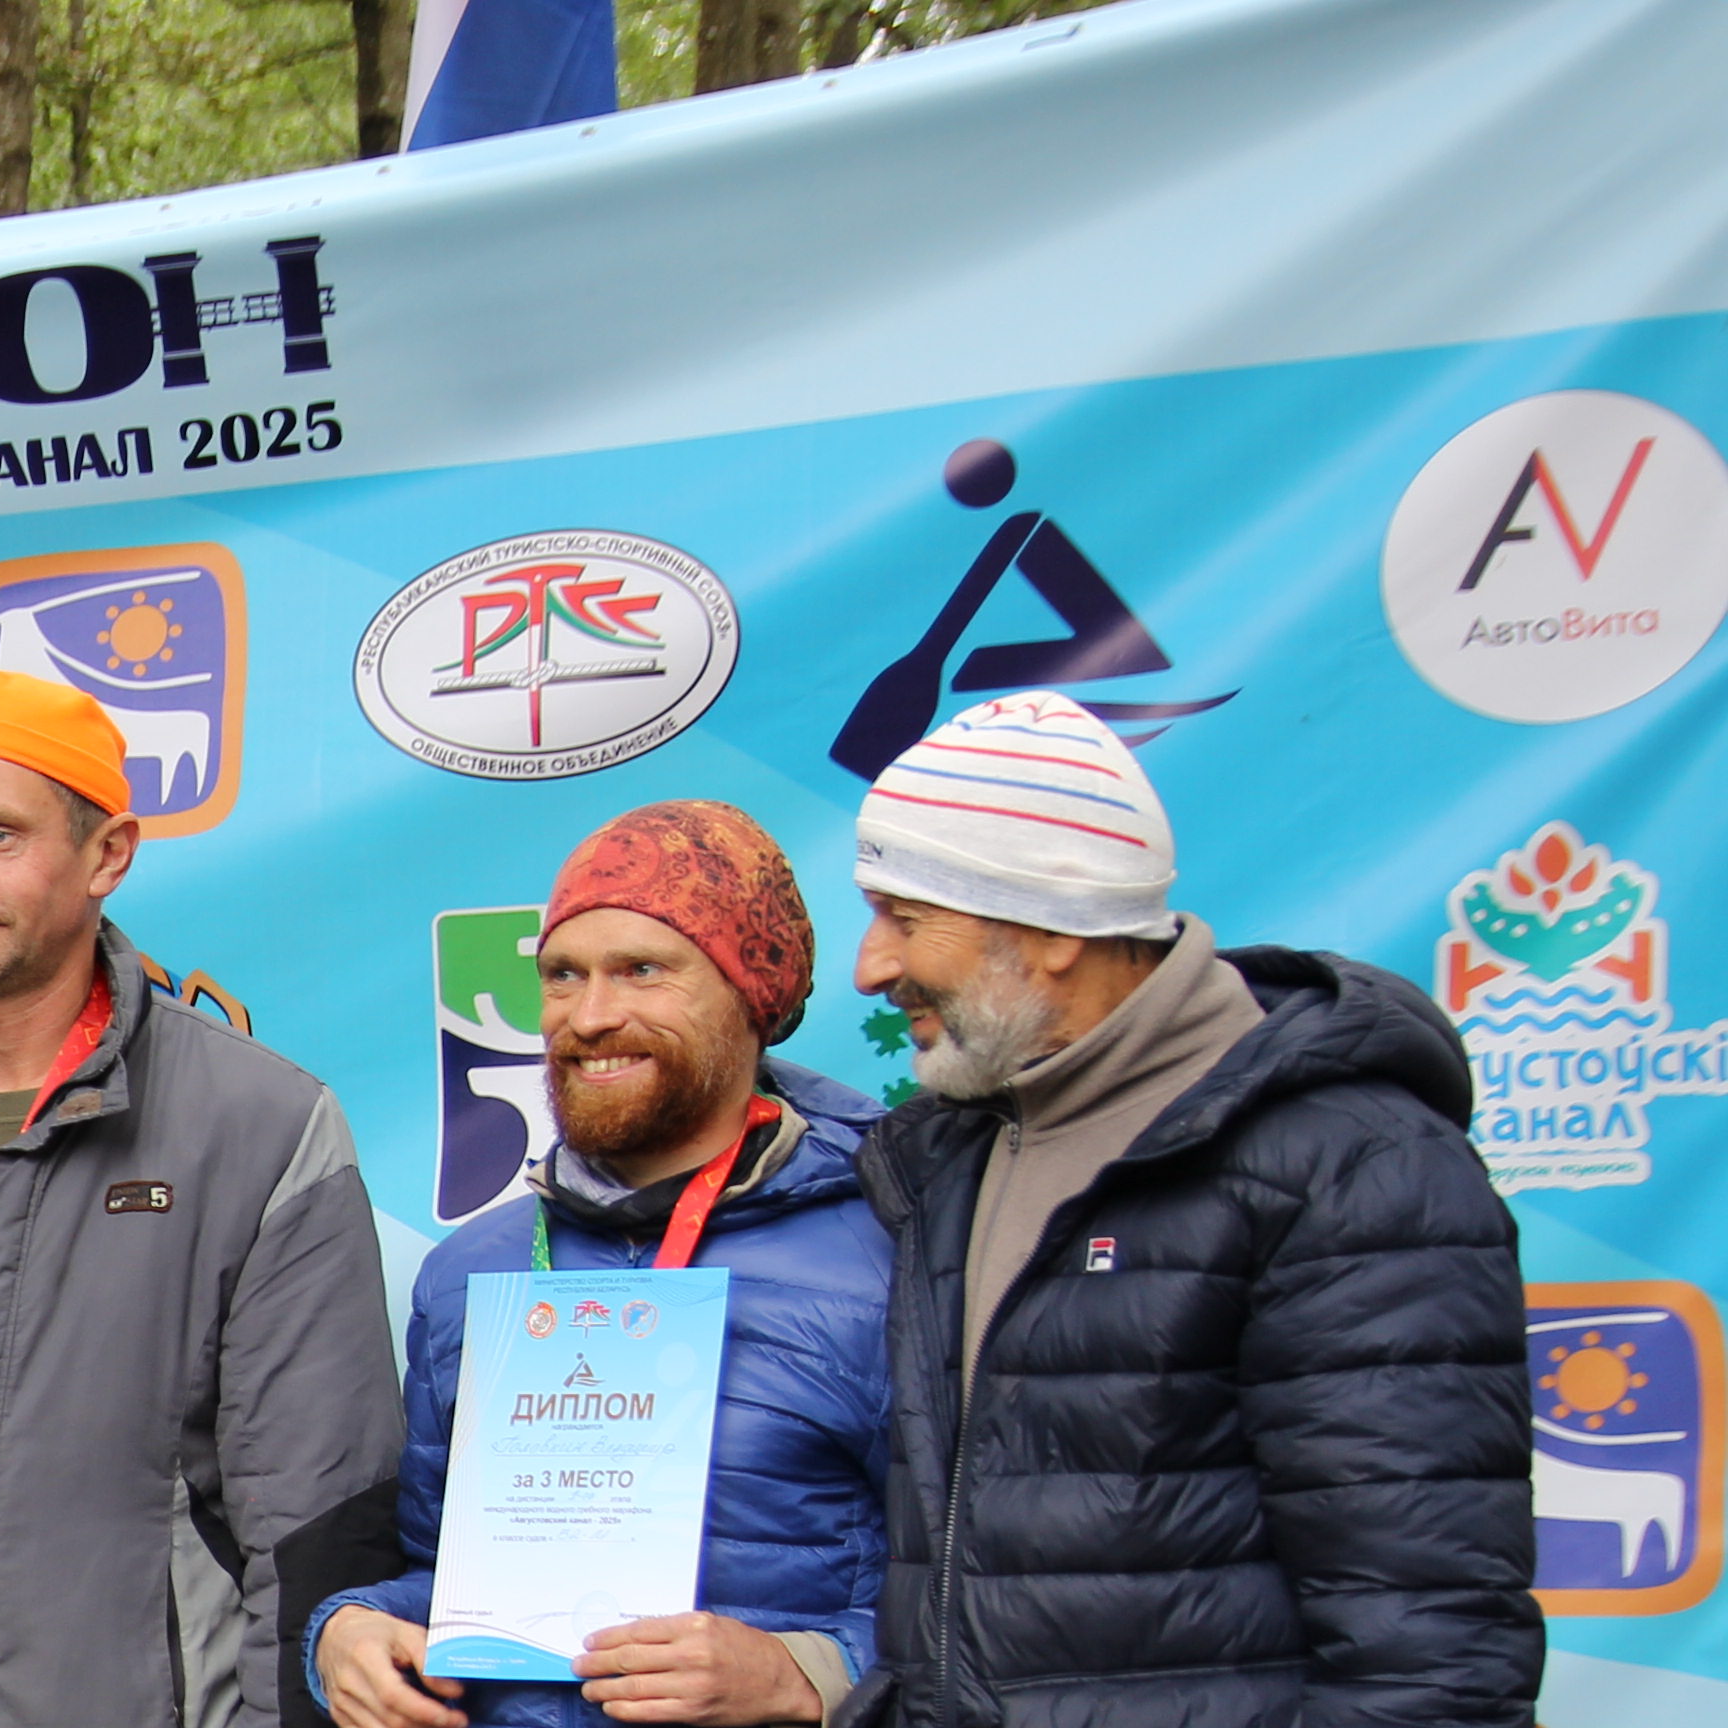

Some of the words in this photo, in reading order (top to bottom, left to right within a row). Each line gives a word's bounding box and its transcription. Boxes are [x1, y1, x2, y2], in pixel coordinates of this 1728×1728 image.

[178, 400, 345, 471] 2025
[1459, 606, 1660, 651] АвтоВита
[410, 737, 547, 776] ОБЩЕСТВЕННОЕ
[550, 716, 679, 773] ОБЪЕДИНЕНИЕ
[510, 1393, 655, 1427] ДИПЛОМ
[511, 1474, 535, 1488] за
[539, 1470, 552, 1488] 3
[557, 1469, 635, 1488] МЕСТО
